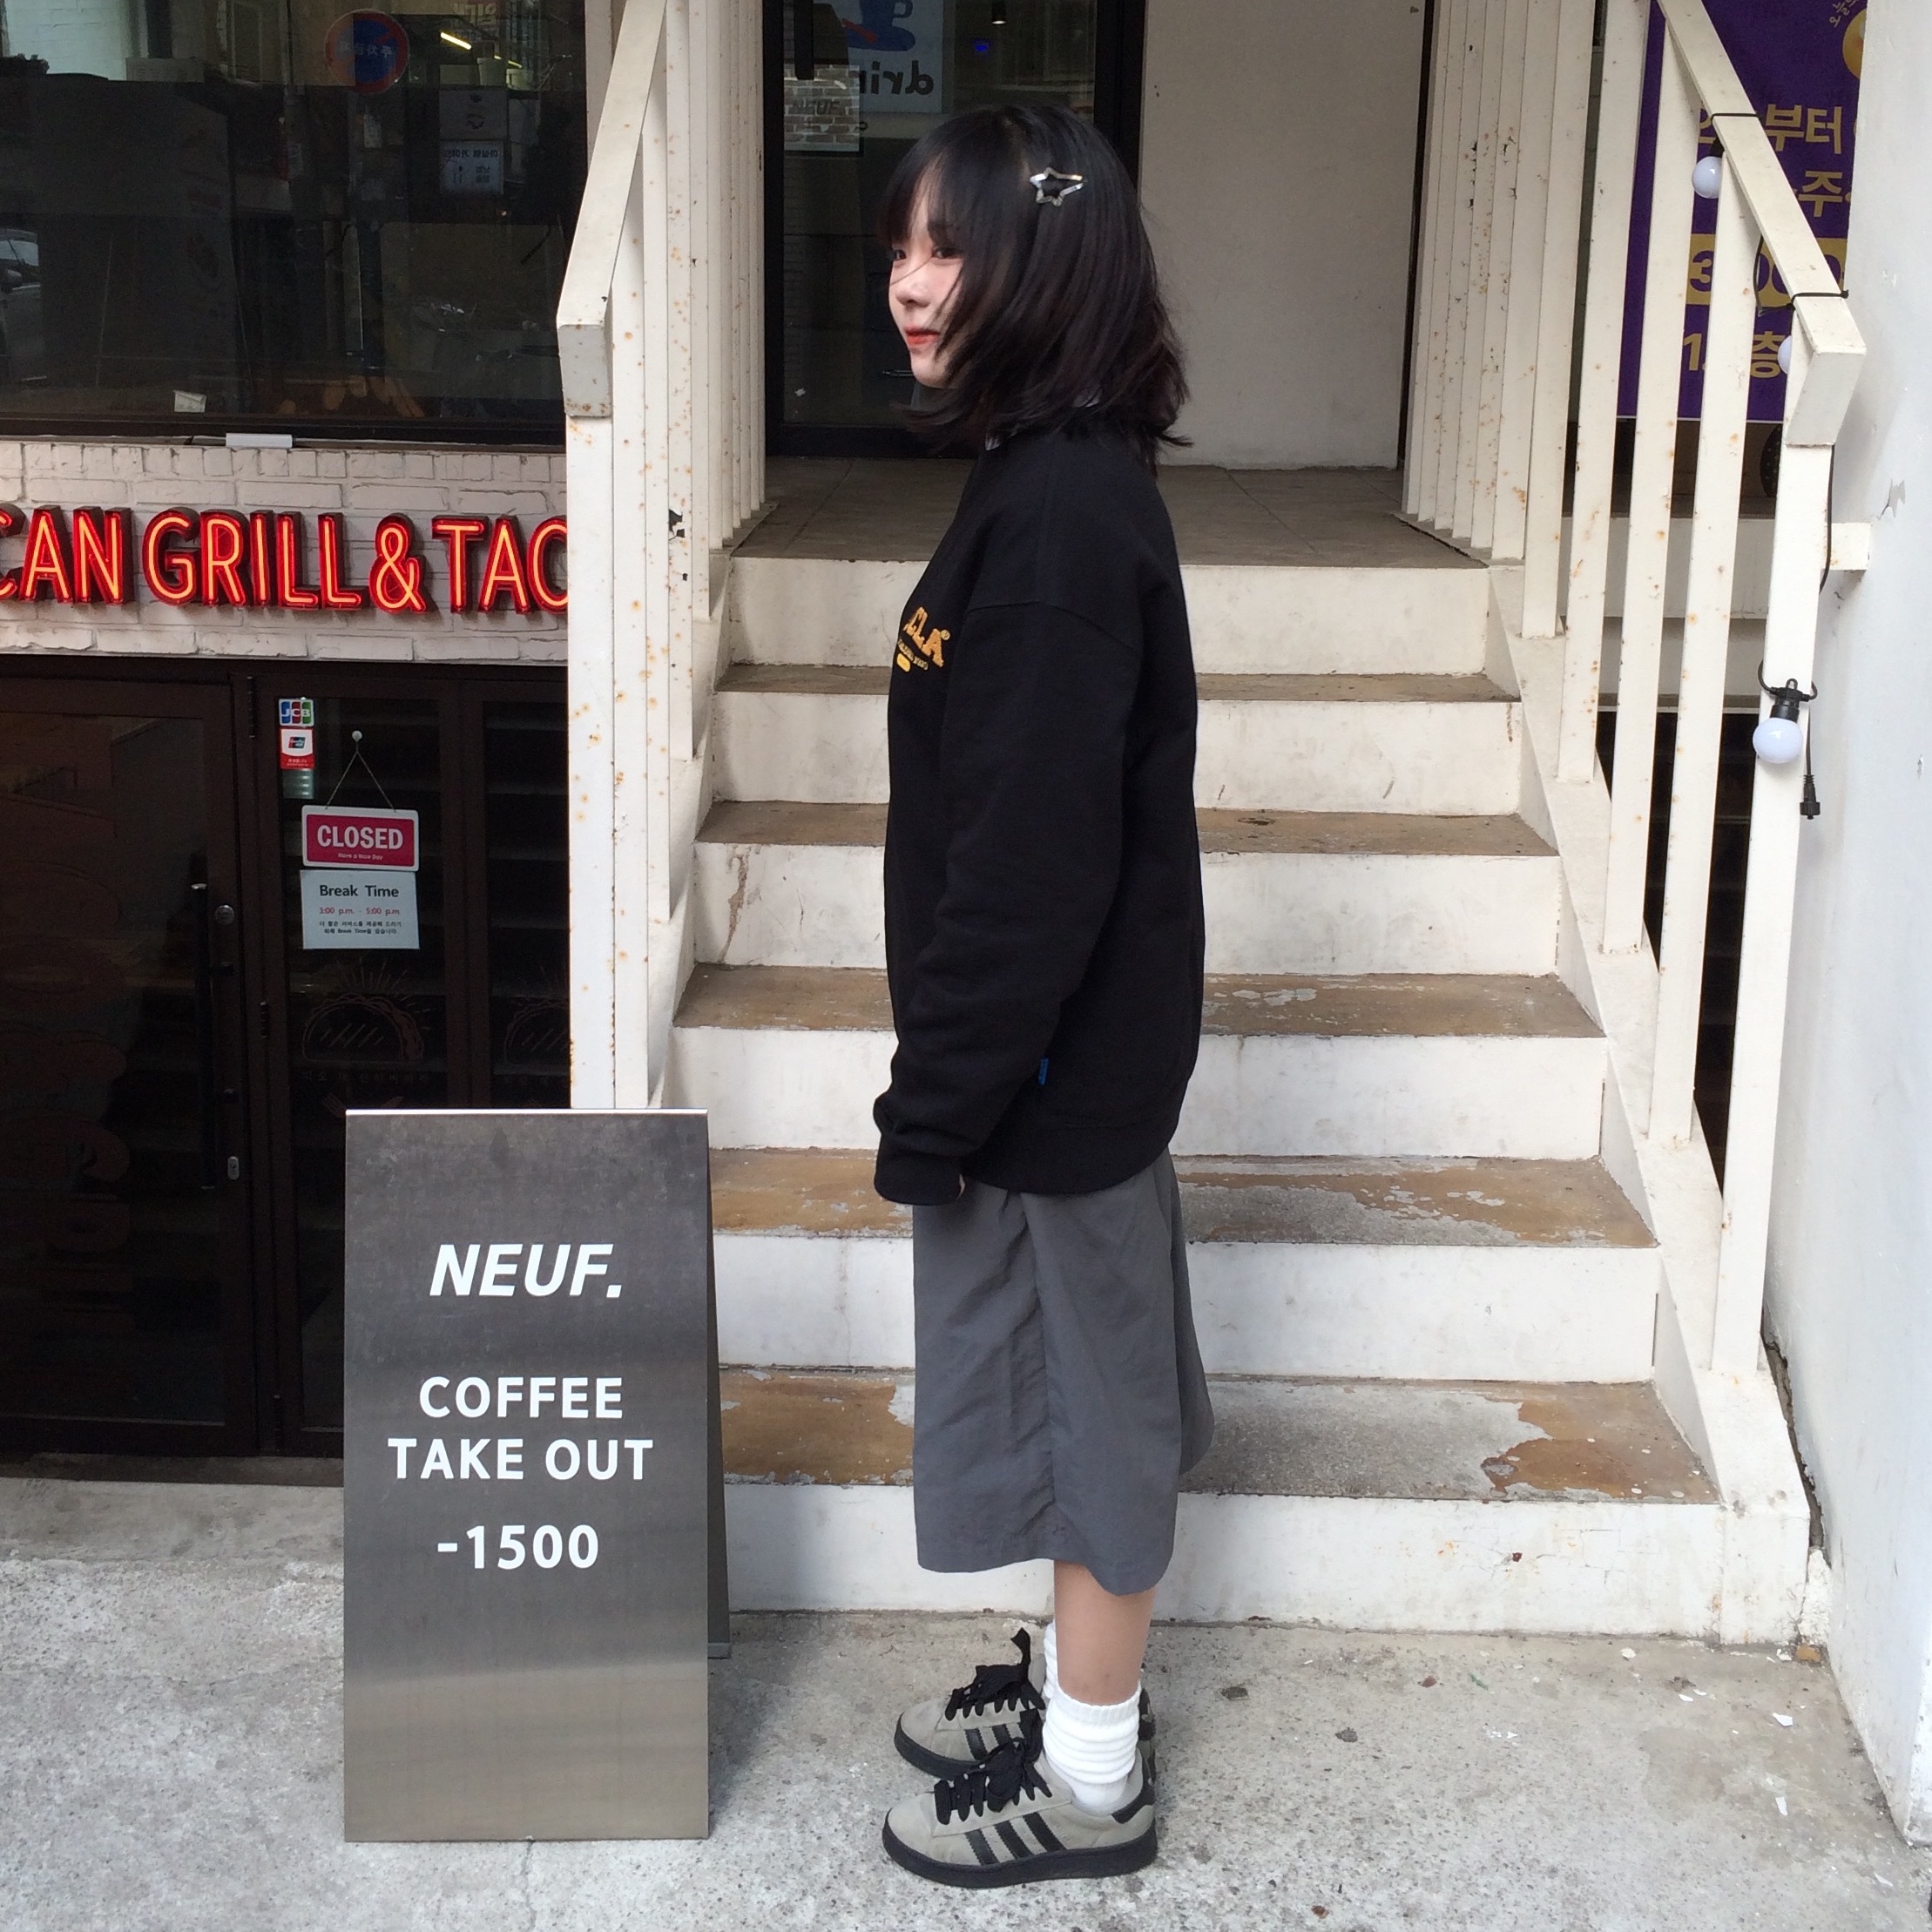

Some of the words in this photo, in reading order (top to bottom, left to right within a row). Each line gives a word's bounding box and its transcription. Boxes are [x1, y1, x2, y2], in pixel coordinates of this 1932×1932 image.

[142, 508, 367, 611] GRILL
[368, 514, 428, 613] &
[280, 707, 311, 718] JCB
[317, 825, 403, 850] CLOSED
[319, 884, 359, 897] Break
[365, 884, 400, 898] Time
[429, 1243, 623, 1299] NEUF.
[419, 1376, 623, 1419] COFFEE
[388, 1438, 524, 1481] TAKE
[545, 1438, 654, 1481] OUT
[437, 1523, 599, 1570] -1500
